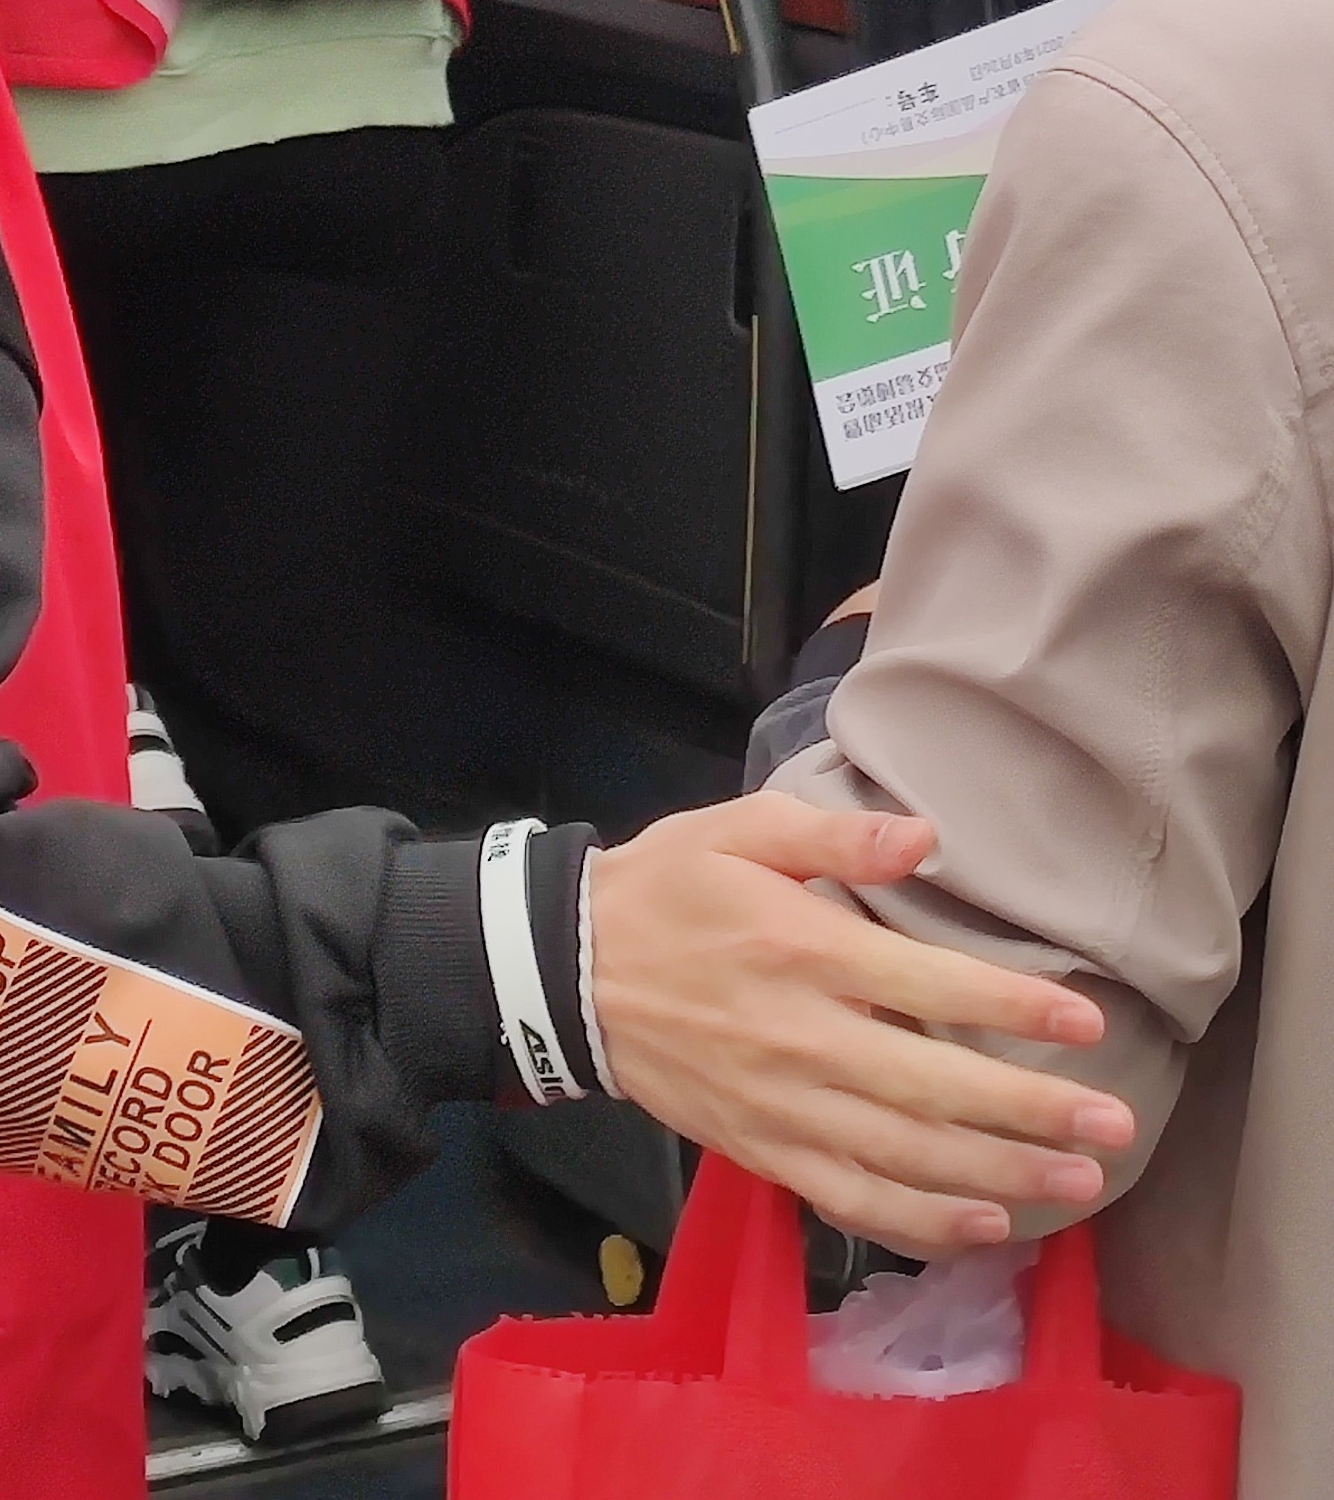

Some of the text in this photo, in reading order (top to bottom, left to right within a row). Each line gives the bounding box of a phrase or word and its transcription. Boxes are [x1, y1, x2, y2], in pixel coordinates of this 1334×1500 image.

[843, 396, 935, 440] 祝活动暨
[152, 1050, 232, 1171] DOOR
